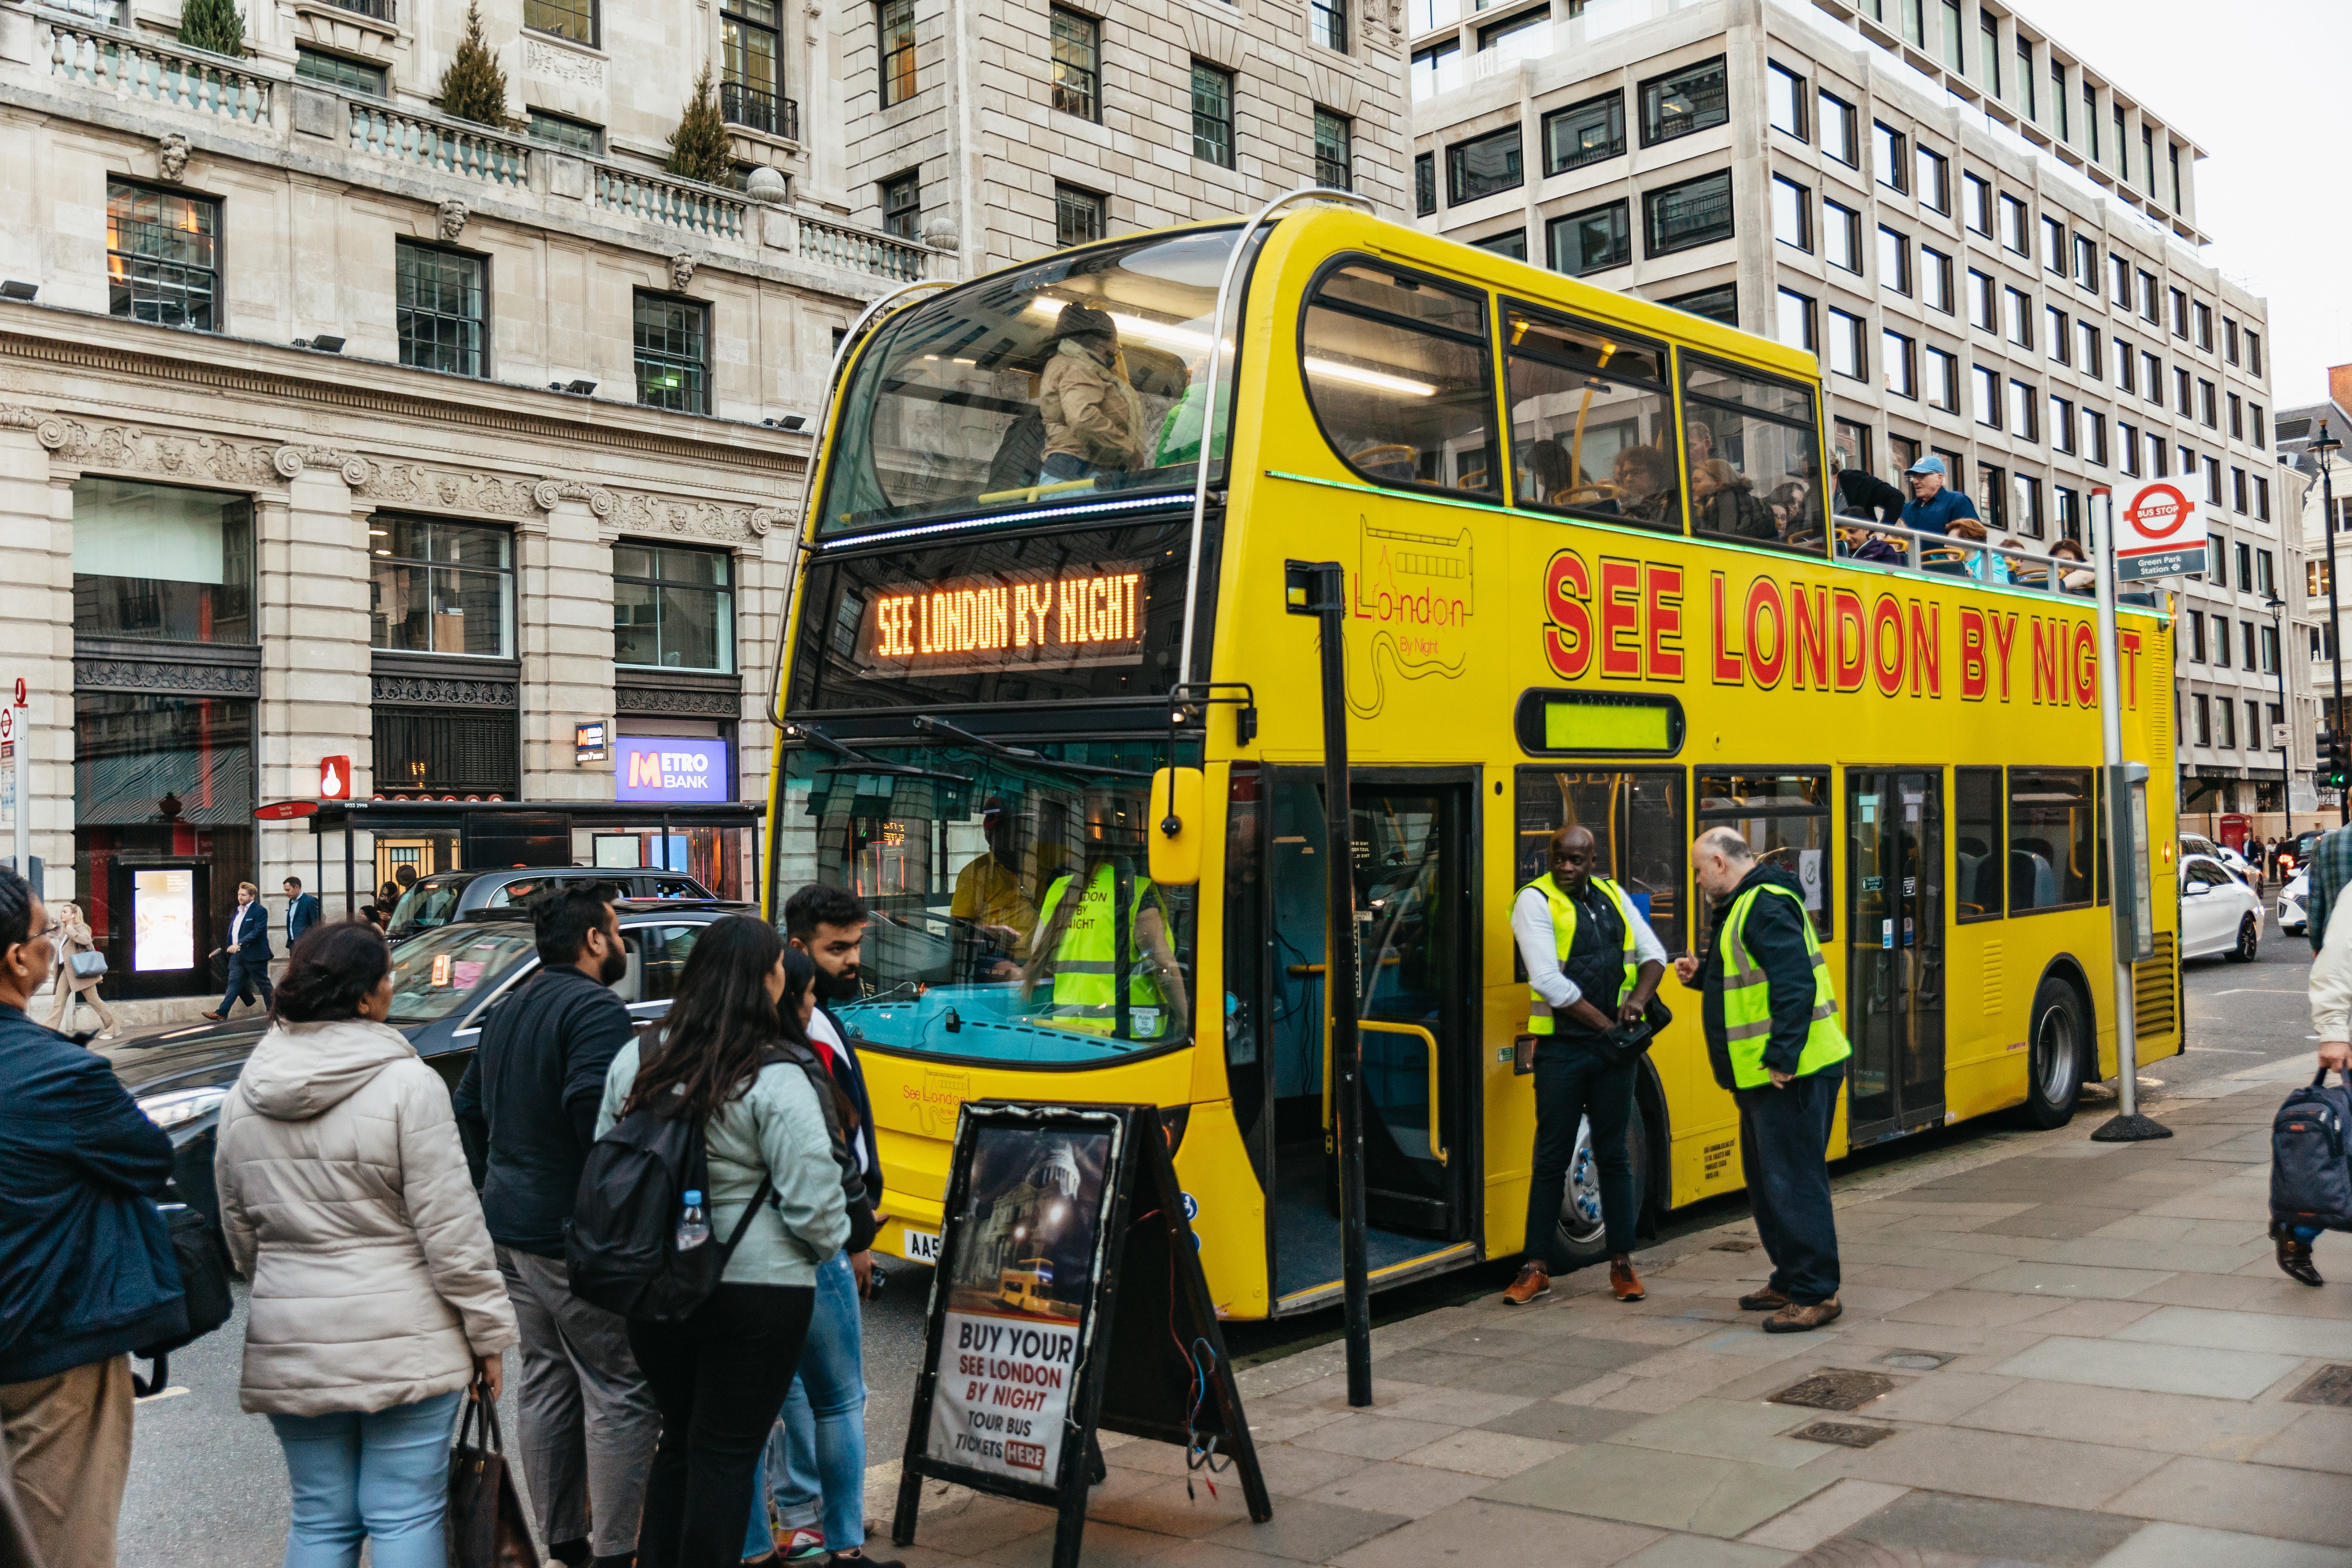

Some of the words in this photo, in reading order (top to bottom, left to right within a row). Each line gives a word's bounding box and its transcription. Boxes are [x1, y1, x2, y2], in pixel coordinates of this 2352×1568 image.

[2137, 509, 2153, 518] BUS
[2156, 505, 2179, 515] STOP
[2141, 566, 2169, 575] Station
[2164, 555, 2181, 563] Park
[878, 596, 914, 656] SEE
[920, 587, 1008, 653] LONDON
[1015, 582, 1052, 646] BY
[1060, 573, 1139, 643] NIGHT
[1354, 573, 1464, 628] London
[1543, 548, 1684, 683] SEE
[1710, 569, 1941, 699] LONDON
[1959, 606, 2019, 703] BY
[2031, 615, 2141, 711] NIGT
[1400, 636, 1412, 656] By
[1415, 637, 1438, 657] Night
[628, 751, 708, 788] METRO
[664, 774, 709, 789] BANK
[1076, 905, 1088, 915] BY
[903, 1085, 921, 1100] See
[959, 1322, 1003, 1353] BUY
[1009, 1328, 1073, 1363] YOUR
[959, 1354, 984, 1376] SEE
[989, 1359, 1062, 1389] LONDON
[966, 1381, 989, 1402] BY
[992, 1385, 1047, 1412] NIGHT
[968, 1410, 1003, 1431] TOUR
[1006, 1418, 1032, 1437] BUS
[956, 1433, 1003, 1458] TICKETS
[1007, 1443, 1044, 1466] HERE
